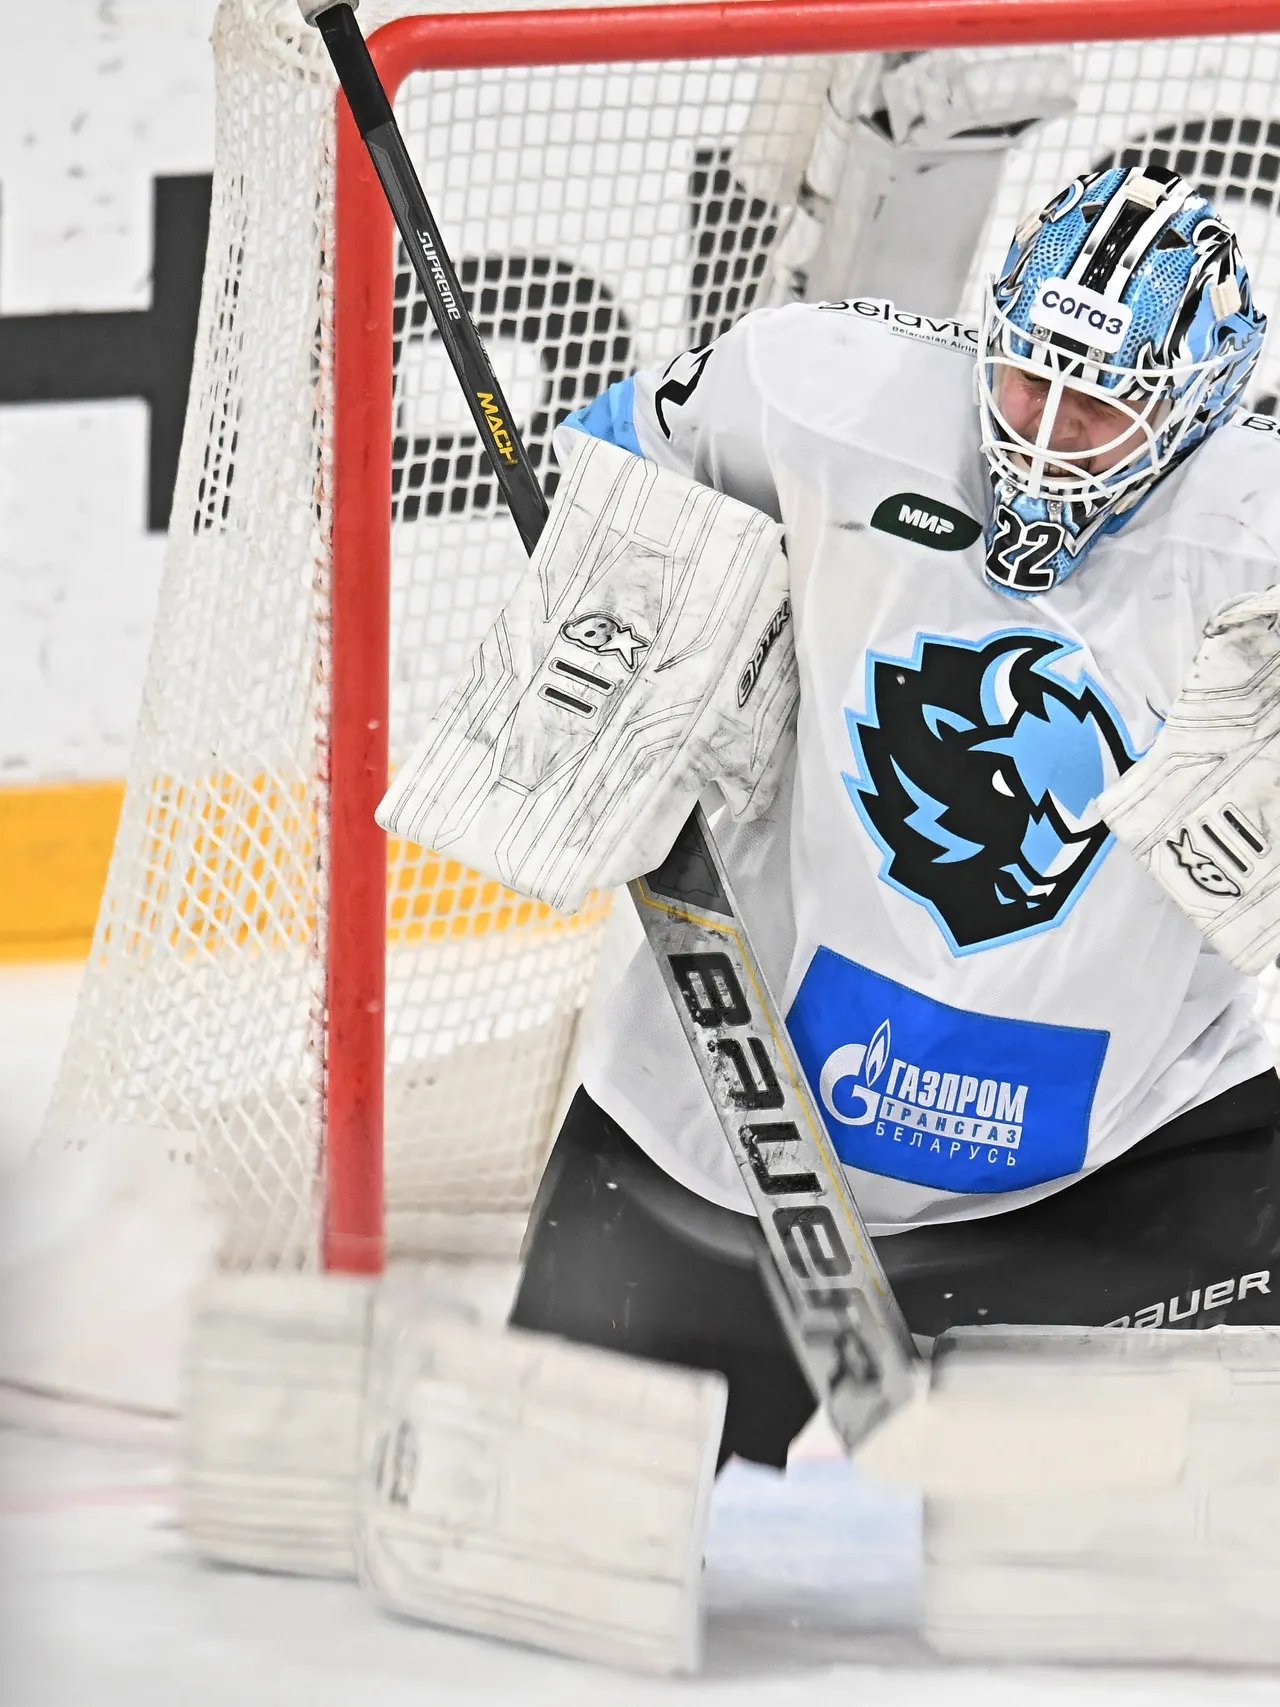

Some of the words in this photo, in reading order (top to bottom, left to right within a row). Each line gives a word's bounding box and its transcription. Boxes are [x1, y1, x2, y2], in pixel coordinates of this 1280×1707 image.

[416, 227, 461, 321] SUPREME
[1042, 290, 1123, 335] согаз
[892, 325, 947, 345] Belarusian
[950, 341, 980, 355] Airlin
[476, 391, 518, 465] MACH
[897, 503, 955, 535] МИР
[984, 504, 1065, 591] 22
[885, 1057, 1029, 1124] ГАЗПРОМ
[875, 1121, 1017, 1167] БЕЛАРУСЬ
[883, 1100, 1018, 1145] ТРАНСГАЗ
